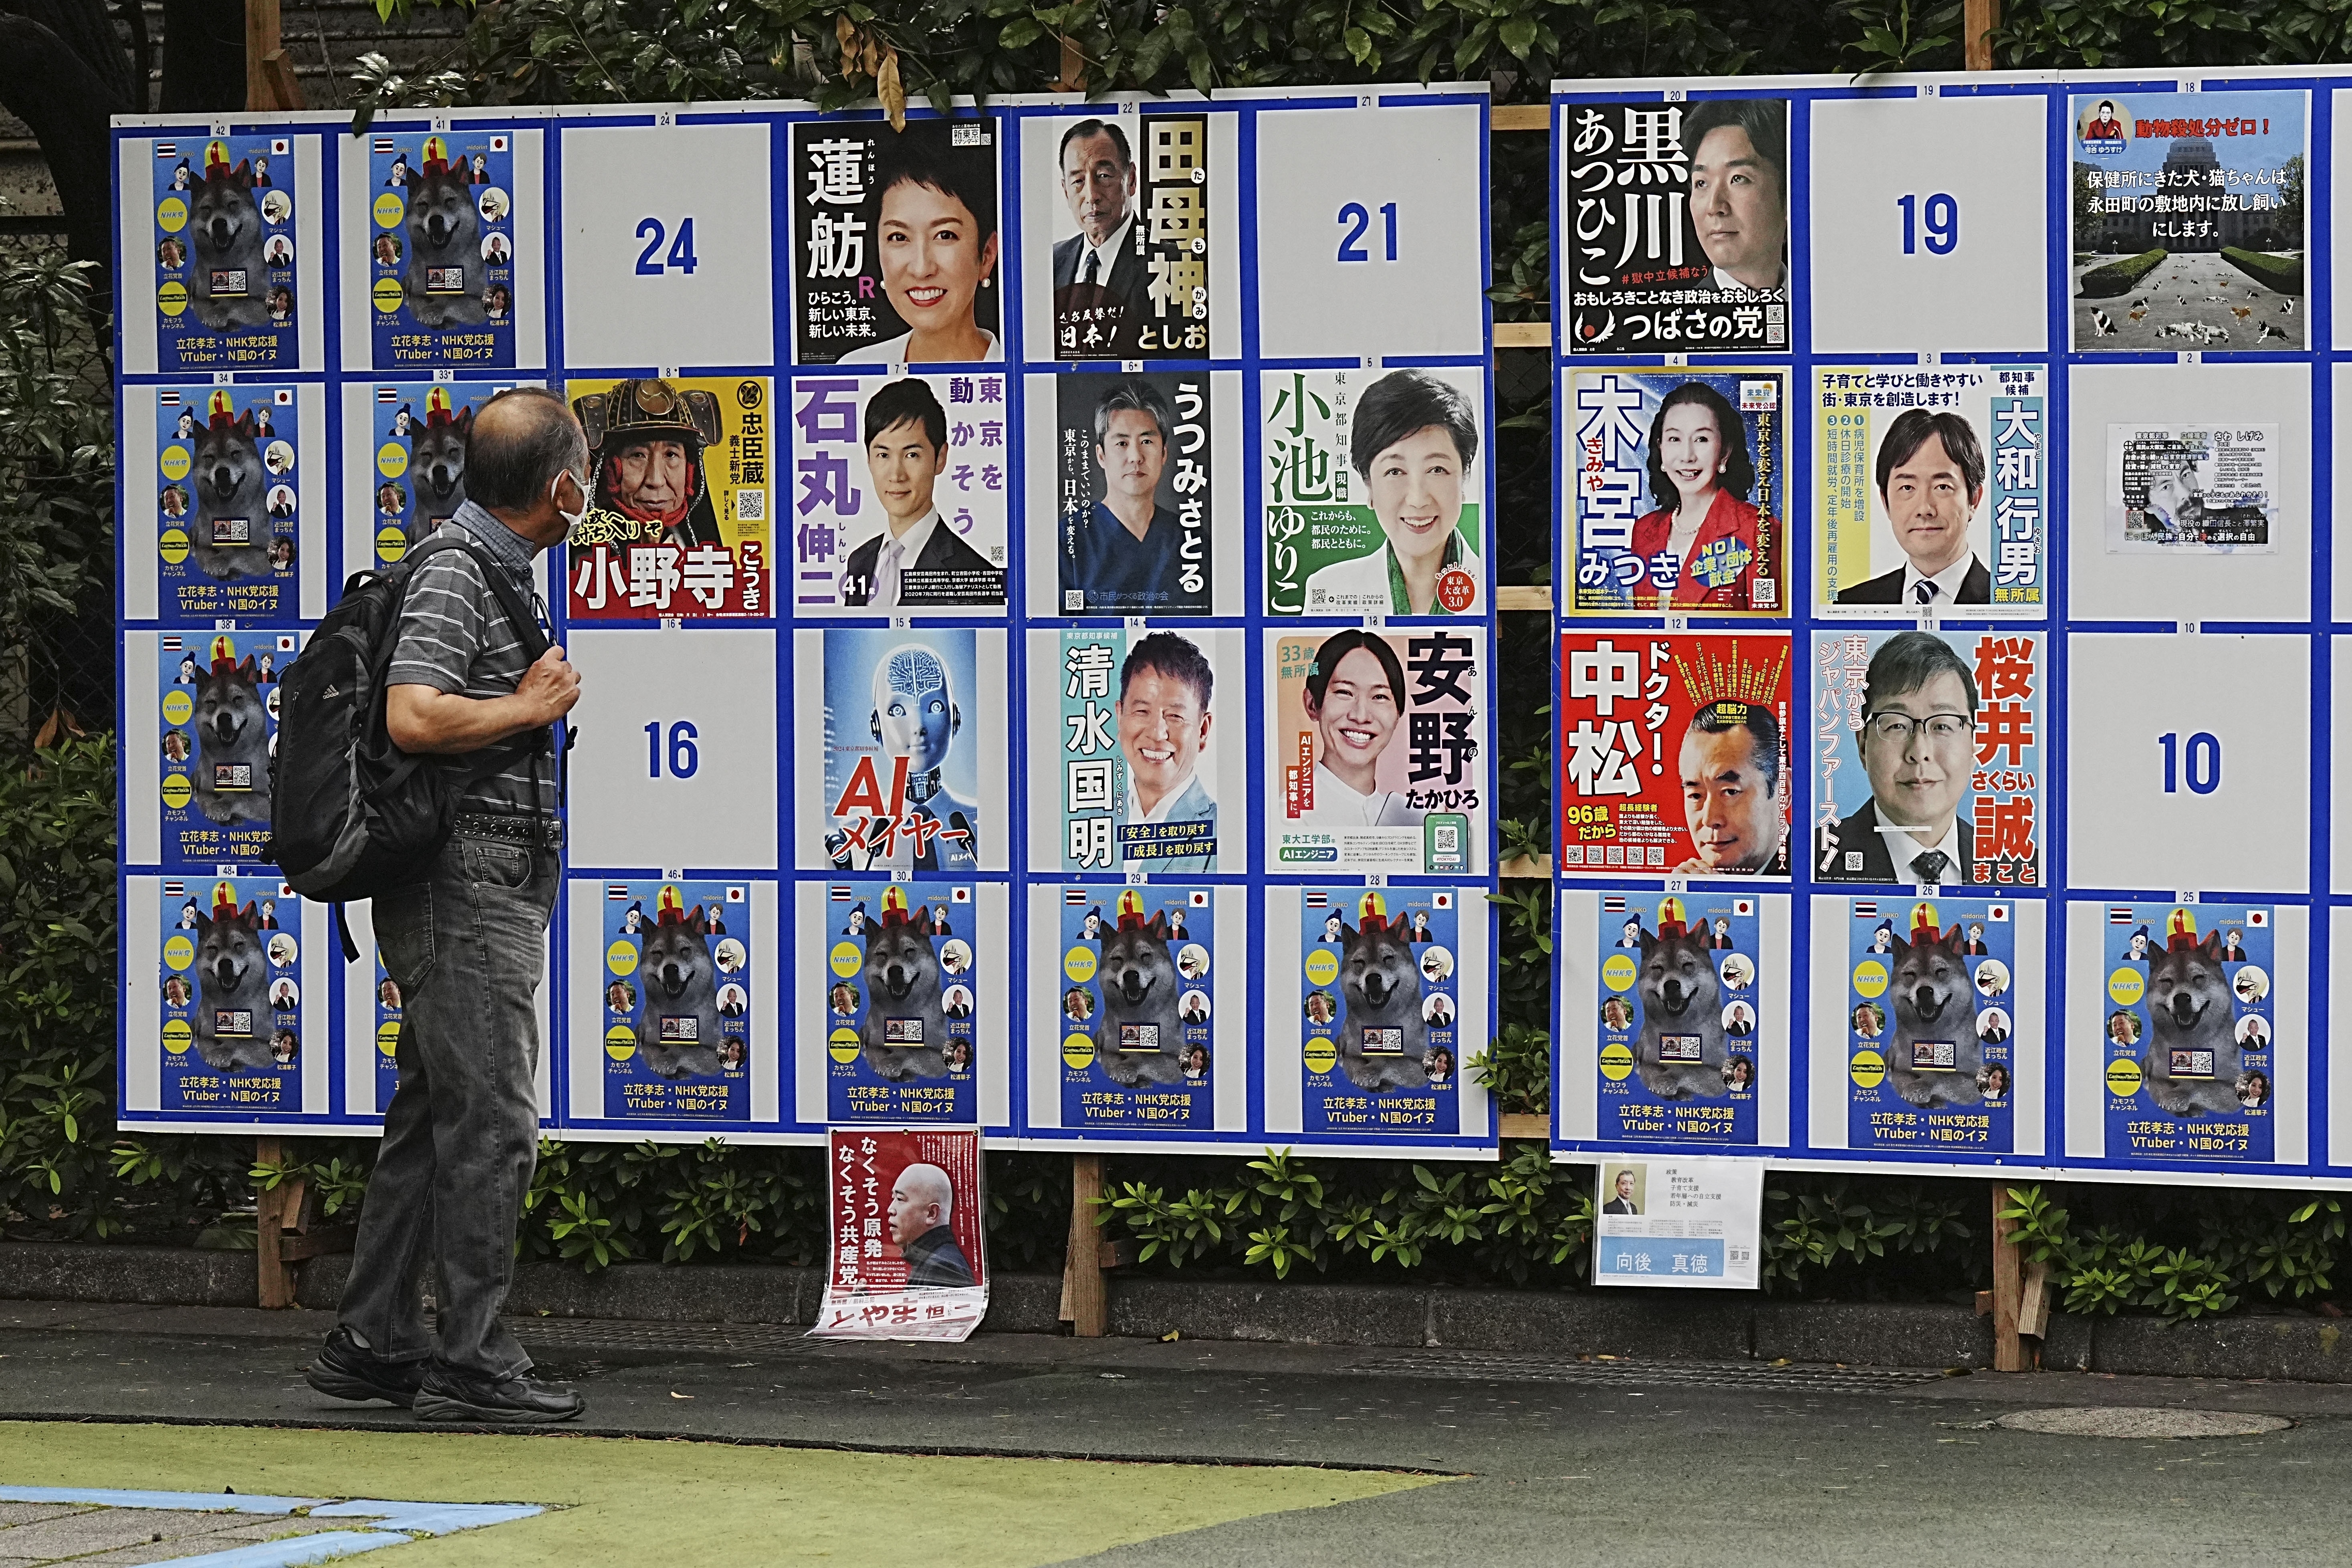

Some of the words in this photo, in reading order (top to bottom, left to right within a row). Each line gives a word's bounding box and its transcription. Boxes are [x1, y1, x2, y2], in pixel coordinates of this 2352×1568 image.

[1670, 91, 1680, 100] 20
[2186, 83, 2194, 92] 18
[1123, 104, 1132, 113] 22
[661, 116, 670, 125] 24
[216, 126, 225, 135] 42
[954, 129, 978, 139] 新東京
[867, 139, 875, 184] れんほう
[1617, 107, 1688, 269] 黒川
[2088, 169, 2286, 189] 保健所にきた犬・猫ちゃんは
[1571, 109, 1615, 285] あつひこ
[2088, 194, 2286, 213] 永田町の敷地内に放し飼い
[807, 139, 866, 278] 蓮舫
[1147, 121, 1204, 317] 田母神
[1898, 194, 1957, 254] 19
[1338, 202, 1397, 261] 21
[2153, 222, 2218, 237] にします。
[635, 218, 697, 275] 24
[1136, 225, 1145, 255] 無所属
[859, 276, 874, 298] R
[809, 291, 856, 305] ひらこう。
[809, 307, 876, 321] 新しい東京、
[1623, 306, 1763, 340] つばさの党
[809, 323, 876, 338] 新しい未来。
[1139, 325, 1206, 349] としお
[176, 336, 277, 349] 立花孝志・NHK党応援
[220, 374, 228, 382] 34
[440, 370, 448, 379] 33
[666, 368, 670, 377] 8
[1822, 373, 1983, 389] 子育てと学びと働きやすい
[1999, 372, 2035, 382] 都知事
[1747, 389, 1770, 397] 未来党
[2005, 385, 2029, 395] 候補
[1334, 371, 1347, 467] 東京都知事
[979, 377, 1003, 490] 東京を
[1267, 373, 1333, 502] 小池
[2215, 432, 2232, 441] さわ
[2237, 432, 2263, 441] しげみ
[741, 412, 764, 484] 忠臣蔵
[950, 377, 974, 535] 動かそう
[729, 435, 740, 484] 義士新党
[1577, 375, 1644, 552] 木宮
[1586, 438, 1604, 492] きみや
[1063, 429, 1079, 558] 東京から、日本を変える。
[1173, 383, 1207, 593] うつみさとる
[1336, 475, 1347, 500] 現職
[1756, 413, 1771, 576] 東京を変え日本を変える
[1311, 511, 1356, 521] これからも、
[1311, 525, 1370, 535] 都民のために。
[1311, 539, 1366, 549] 都民とともに。
[1269, 507, 1304, 612] ゆりこ
[575, 545, 733, 609] 小野寺
[743, 545, 761, 609] こうき
[1447, 576, 1463, 585] 東京
[1579, 553, 1679, 589] みつき
[1709, 569, 1735, 588] 献金
[177, 585, 278, 597] 立花孝志・NHK党応援
[1099, 591, 1168, 601] 市民がつくる政治の会
[1444, 586, 1469, 595] 大改革
[1994, 588, 2040, 602] 無所属
[1448, 596, 1463, 607] 3.0
[1672, 619, 1680, 628] 12
[1281, 663, 1319, 679] 無所属
[1843, 635, 1869, 731] 東京から
[1407, 632, 1477, 785] 安野
[1717, 704, 1747, 714] 超脳力
[1972, 635, 2035, 768] 桜井
[1568, 641, 1643, 797] 中松
[645, 721, 698, 778] 16
[1066, 644, 1114, 869] 清水国明
[1301, 736, 1312, 807] AIエンジニアを
[2159, 732, 2220, 794] 10
[833, 757, 910, 816] AI
[1972, 771, 2035, 792] さくらい
[1406, 789, 1479, 809] たかひろ
[1619, 803, 1657, 812] 超長経験者
[1568, 805, 1609, 824] 96歳
[180, 830, 272, 842] 立花孝志・NHK党応
[831, 813, 969, 859] メイヤー
[1120, 824, 1207, 839] 「安全」を取り戻す
[1579, 823, 1616, 840] だから
[1973, 796, 2035, 862] 誠
[1128, 842, 1214, 857] 「成長」を取り戻す
[1283, 850, 1334, 859] AIエンジニア
[223, 866, 232, 874] 48
[1132, 874, 1140, 883] 29
[1974, 863, 2035, 883] まこと
[1923, 886, 1932, 895] 26
[2184, 892, 2193, 902] 25
[2112, 982, 2140, 991] NHK党
[624, 1084, 728, 1097] 立花孝志・NHK党応援
[847, 1086, 954, 1100] 立花孝志・NHK党応援
[1323, 1097, 1435, 1111] 立花孝志・NHK党応援
[1619, 1105, 1734, 1120] 立花孝志・NHK党応援
[2127, 1121, 2249, 1136] 立花孝志・NHK党応援
[862, 1136, 882, 1258] なくそう原発
[839, 1145, 859, 1285] なくそう共産党
[1617, 1253, 1652, 1271] 向後
[1672, 1254, 1707, 1273] 真徳
[829, 1298, 918, 1329] とやま
